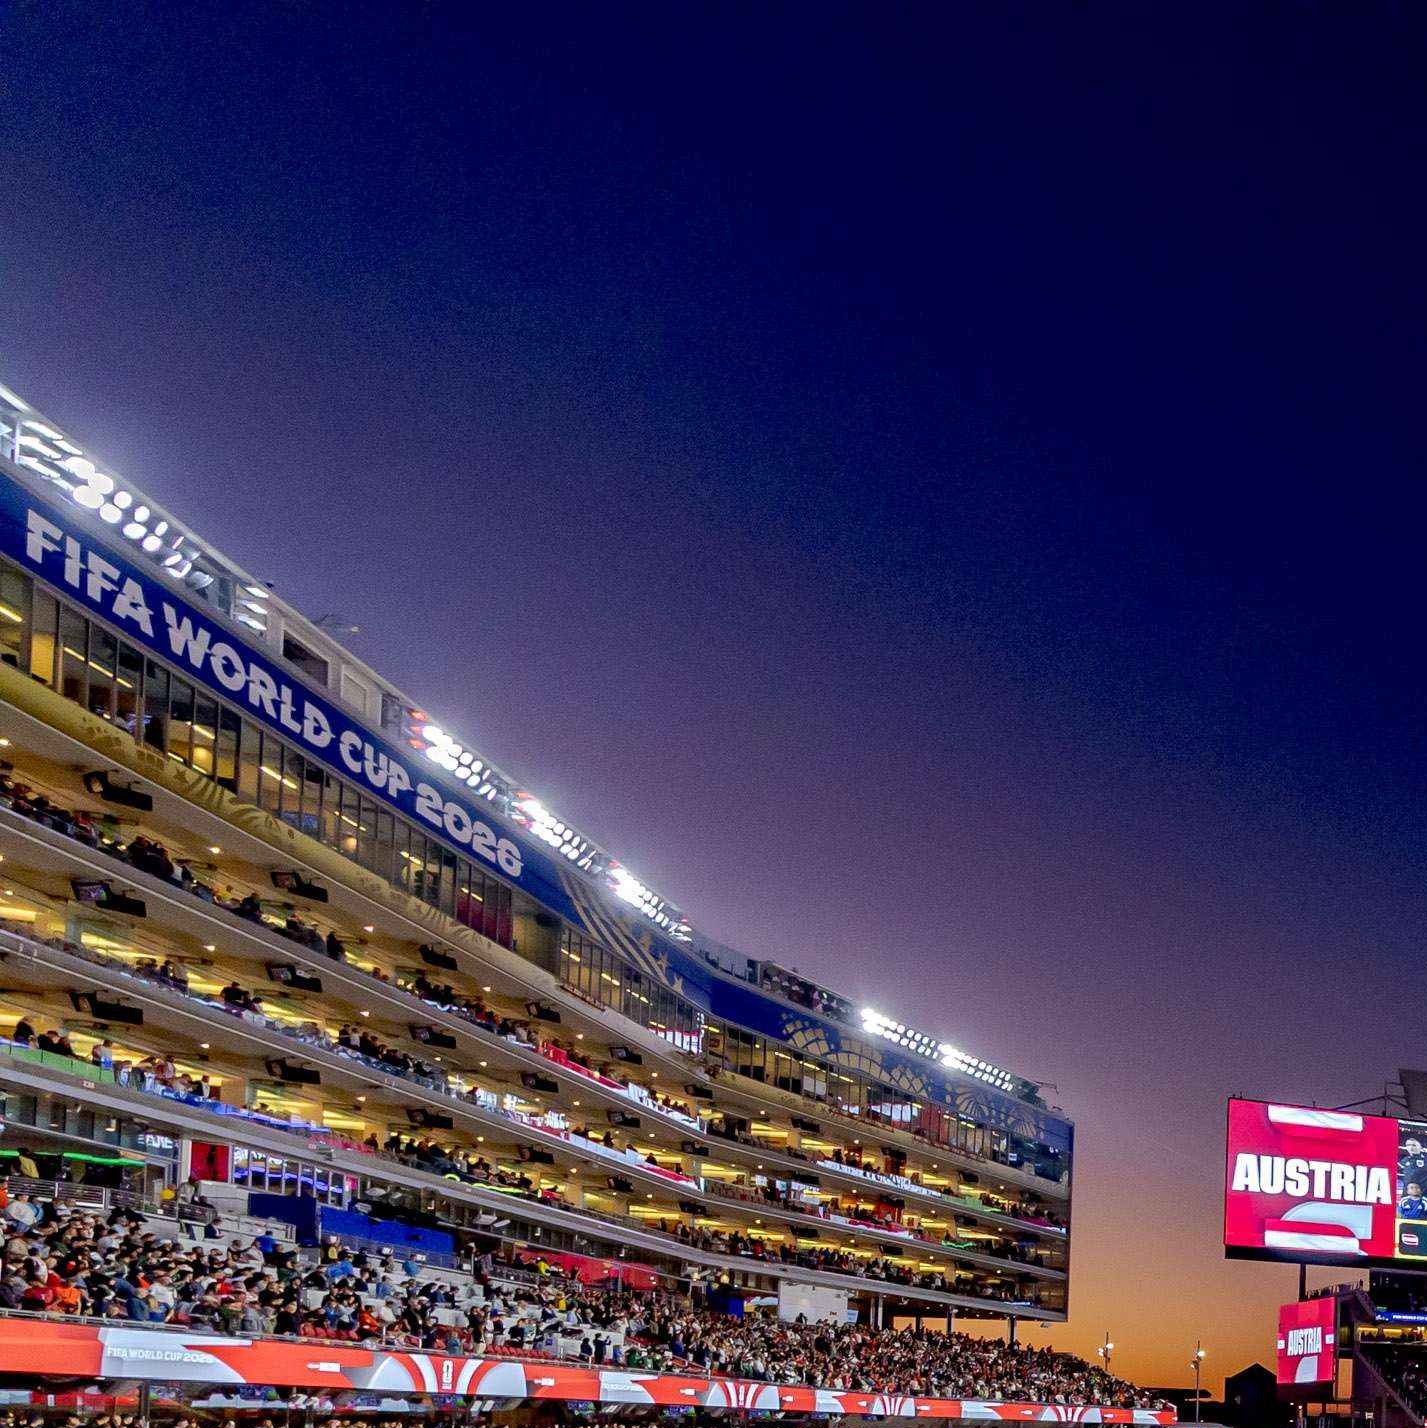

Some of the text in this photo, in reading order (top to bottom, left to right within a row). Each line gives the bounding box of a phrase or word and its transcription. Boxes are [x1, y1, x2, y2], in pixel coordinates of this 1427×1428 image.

[26, 508, 524, 878] FIFA WORLD CUP 2026
[1231, 1153, 1392, 1205] AUSTRIA
[107, 1346, 128, 1359] FIFA
[129, 1348, 163, 1360] WORLD
[164, 1351, 183, 1361] CUP
[1287, 1326, 1322, 1356] AUSTRIA
